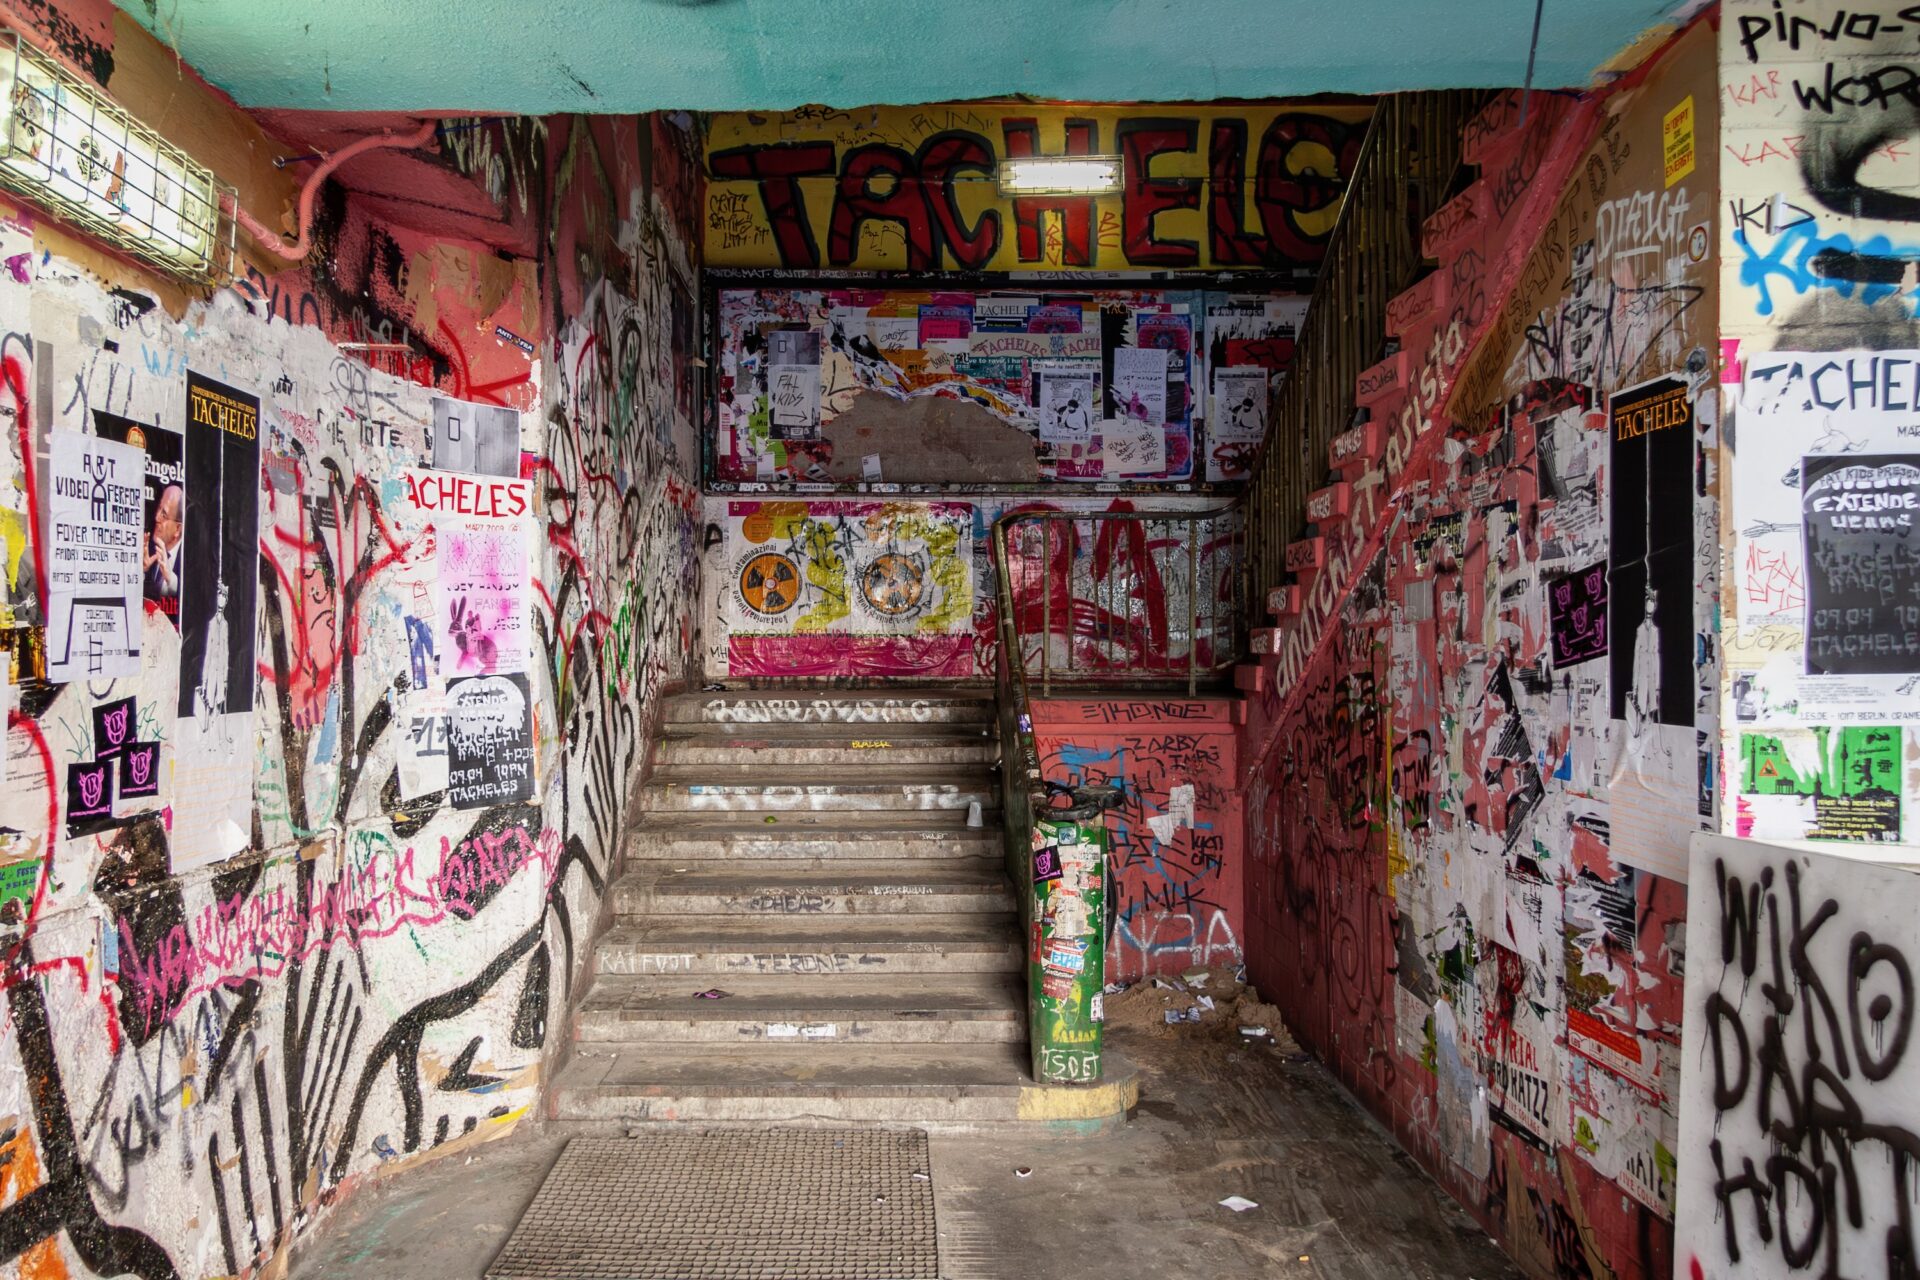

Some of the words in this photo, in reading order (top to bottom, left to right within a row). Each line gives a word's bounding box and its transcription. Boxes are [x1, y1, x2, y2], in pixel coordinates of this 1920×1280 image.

[191, 394, 257, 441] TACHELES
[1615, 396, 1690, 441] TACHELES
[83, 453, 116, 479] ART
[56, 475, 89, 500] VIDEO
[56, 524, 88, 543] FOYER
[92, 526, 137, 547] TACHELES
[448, 779, 518, 801] TACHELES
